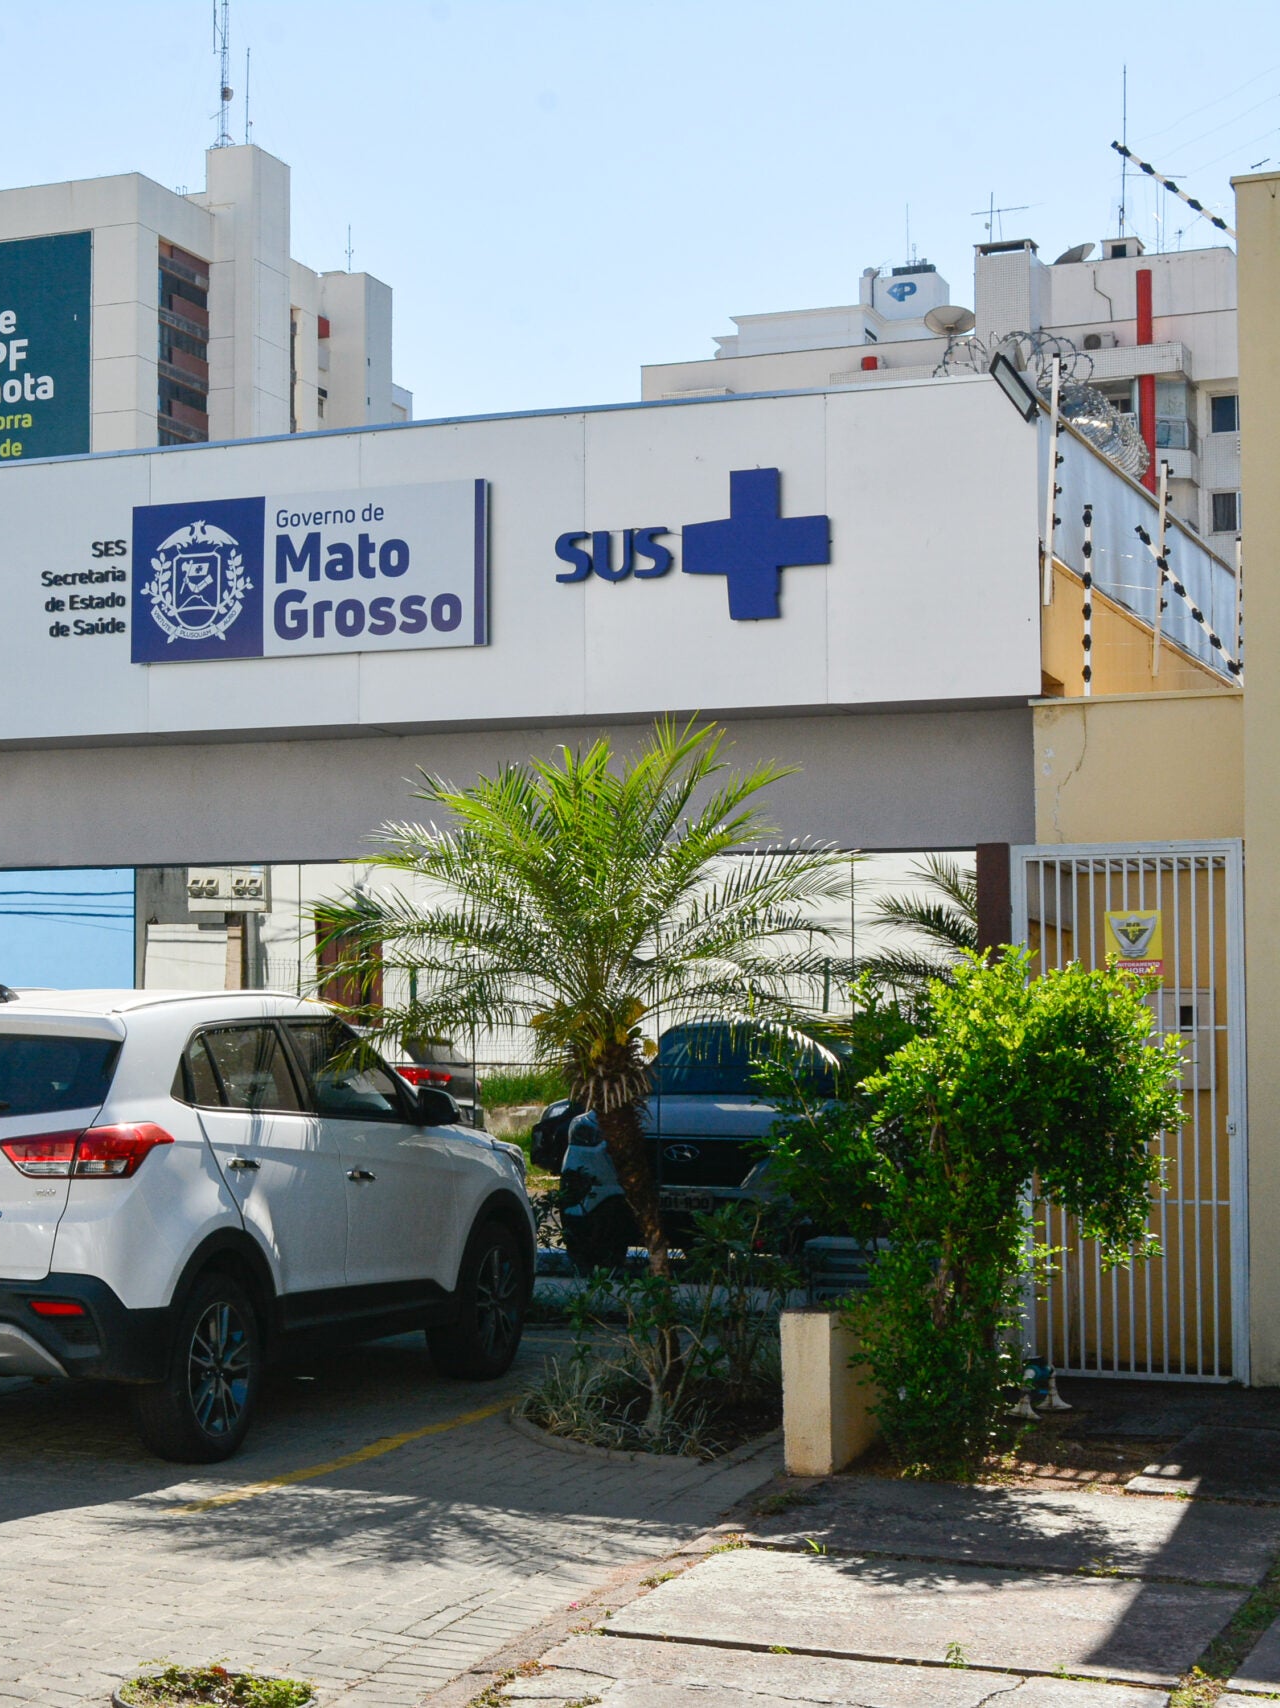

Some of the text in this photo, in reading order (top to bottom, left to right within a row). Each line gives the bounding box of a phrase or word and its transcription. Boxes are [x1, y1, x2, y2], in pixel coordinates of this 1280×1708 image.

[0, 438, 22, 457] de
[276, 503, 384, 528] Governo de
[92, 539, 127, 558] SES
[275, 532, 410, 584] Mato
[555, 526, 674, 583] SUS
[41, 566, 126, 587] Secretaria
[44, 592, 126, 612] de Estado
[153, 609, 237, 639] VIRTUTE PLUSQUAM AURO
[274, 589, 462, 640] Grosso
[48, 617, 126, 638] de Saúde
